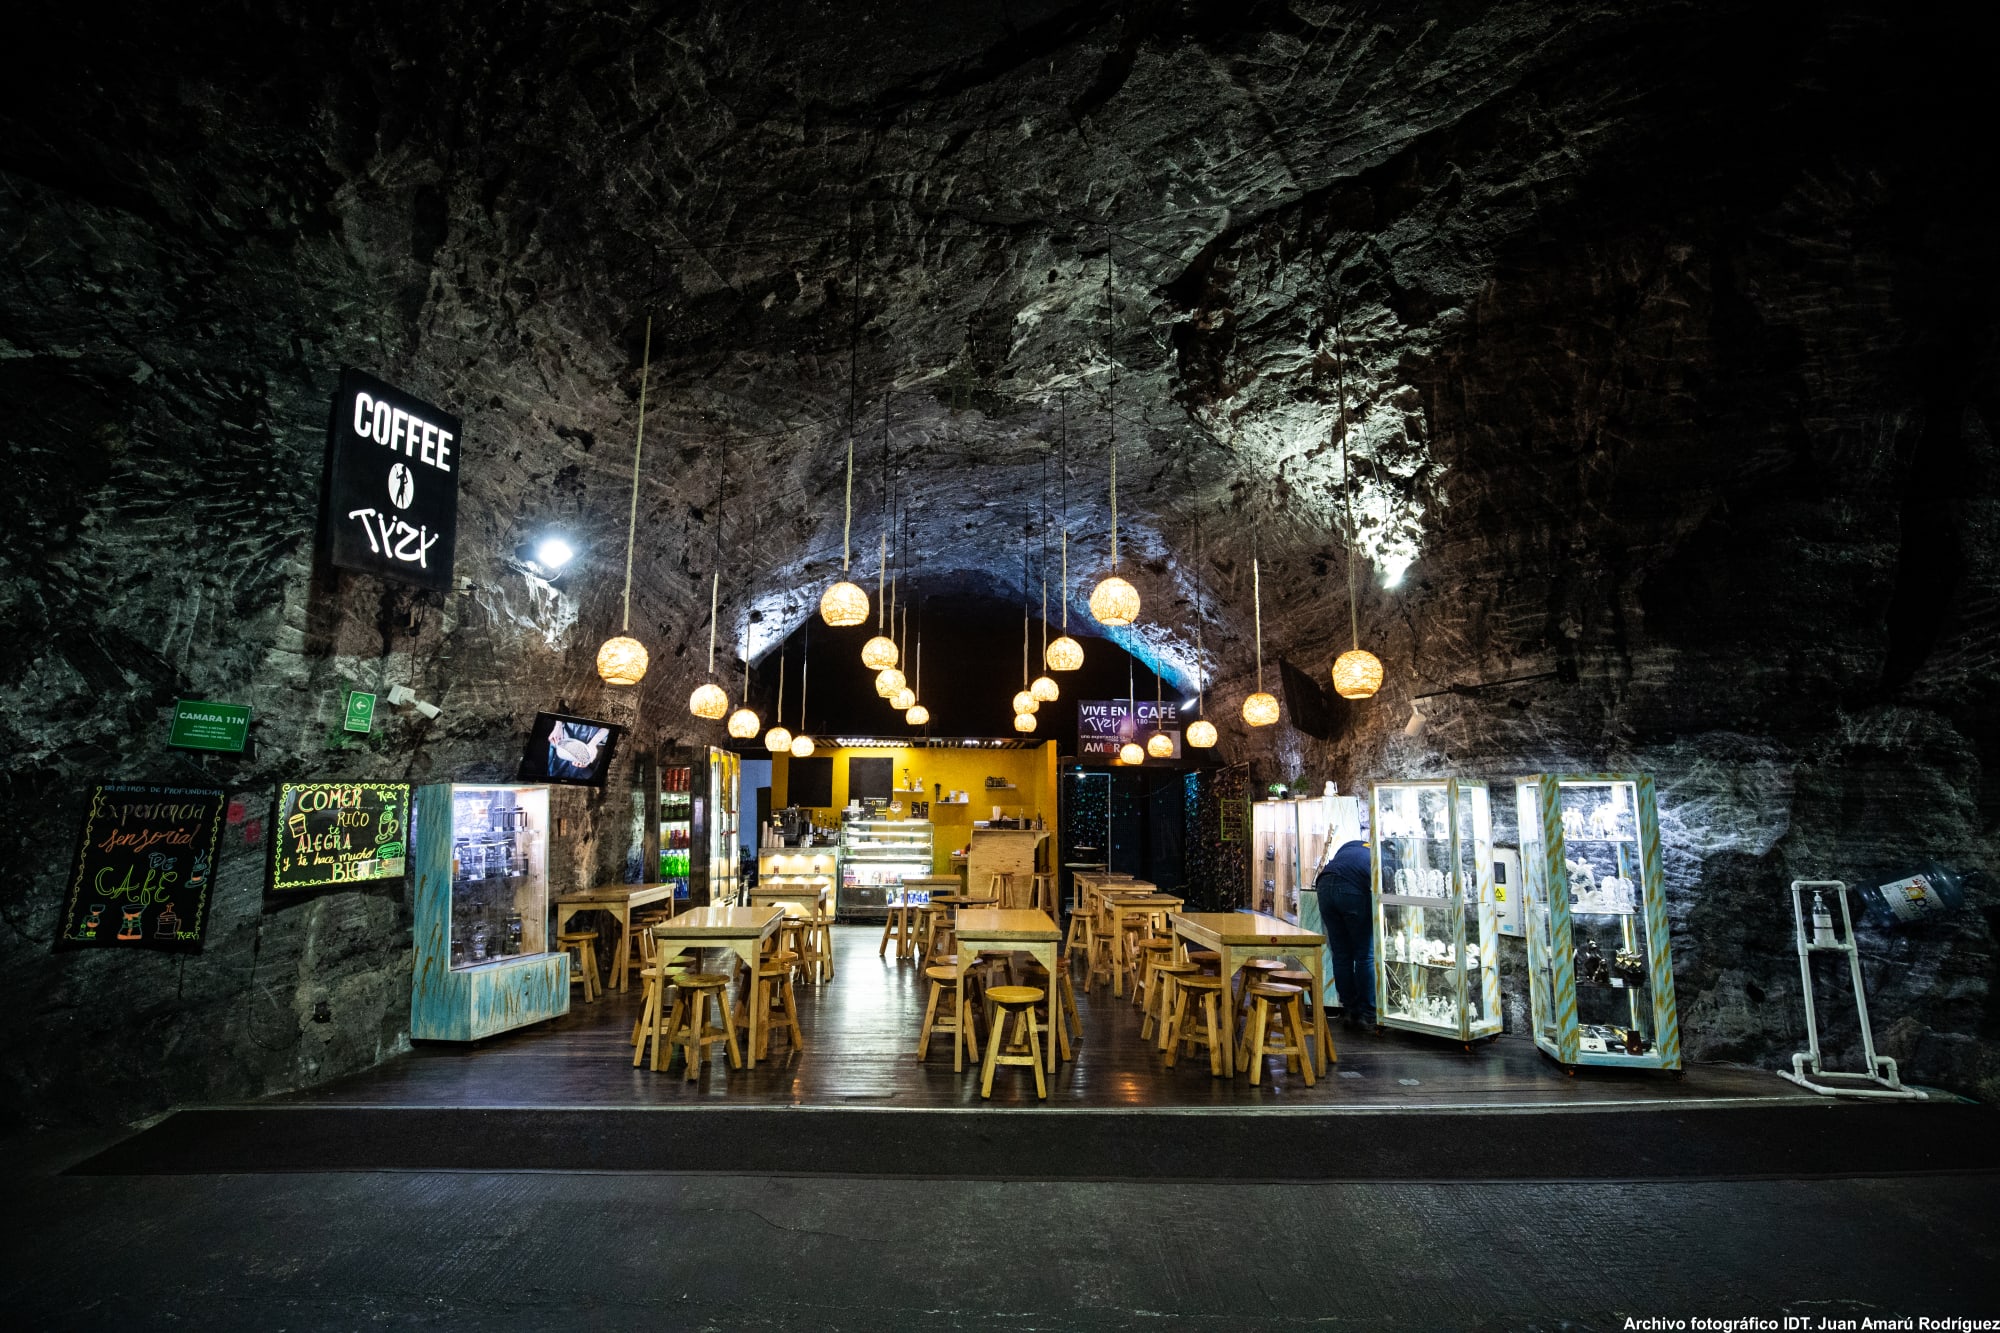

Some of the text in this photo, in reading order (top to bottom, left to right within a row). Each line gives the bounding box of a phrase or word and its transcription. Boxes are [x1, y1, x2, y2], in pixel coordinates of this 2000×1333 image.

[353, 392, 454, 472] COFFEE
[1081, 704, 1127, 716] VIVE EN
[1137, 703, 1176, 719] CAFÉ
[180, 712, 245, 725] CAMARA 11N
[298, 788, 363, 813] COMER
[336, 811, 370, 827] RICO
[328, 824, 341, 835] te
[295, 833, 352, 854] ALEGRA
[297, 854, 308, 866] te
[313, 852, 335, 866] hace
[339, 847, 376, 863] mucho
